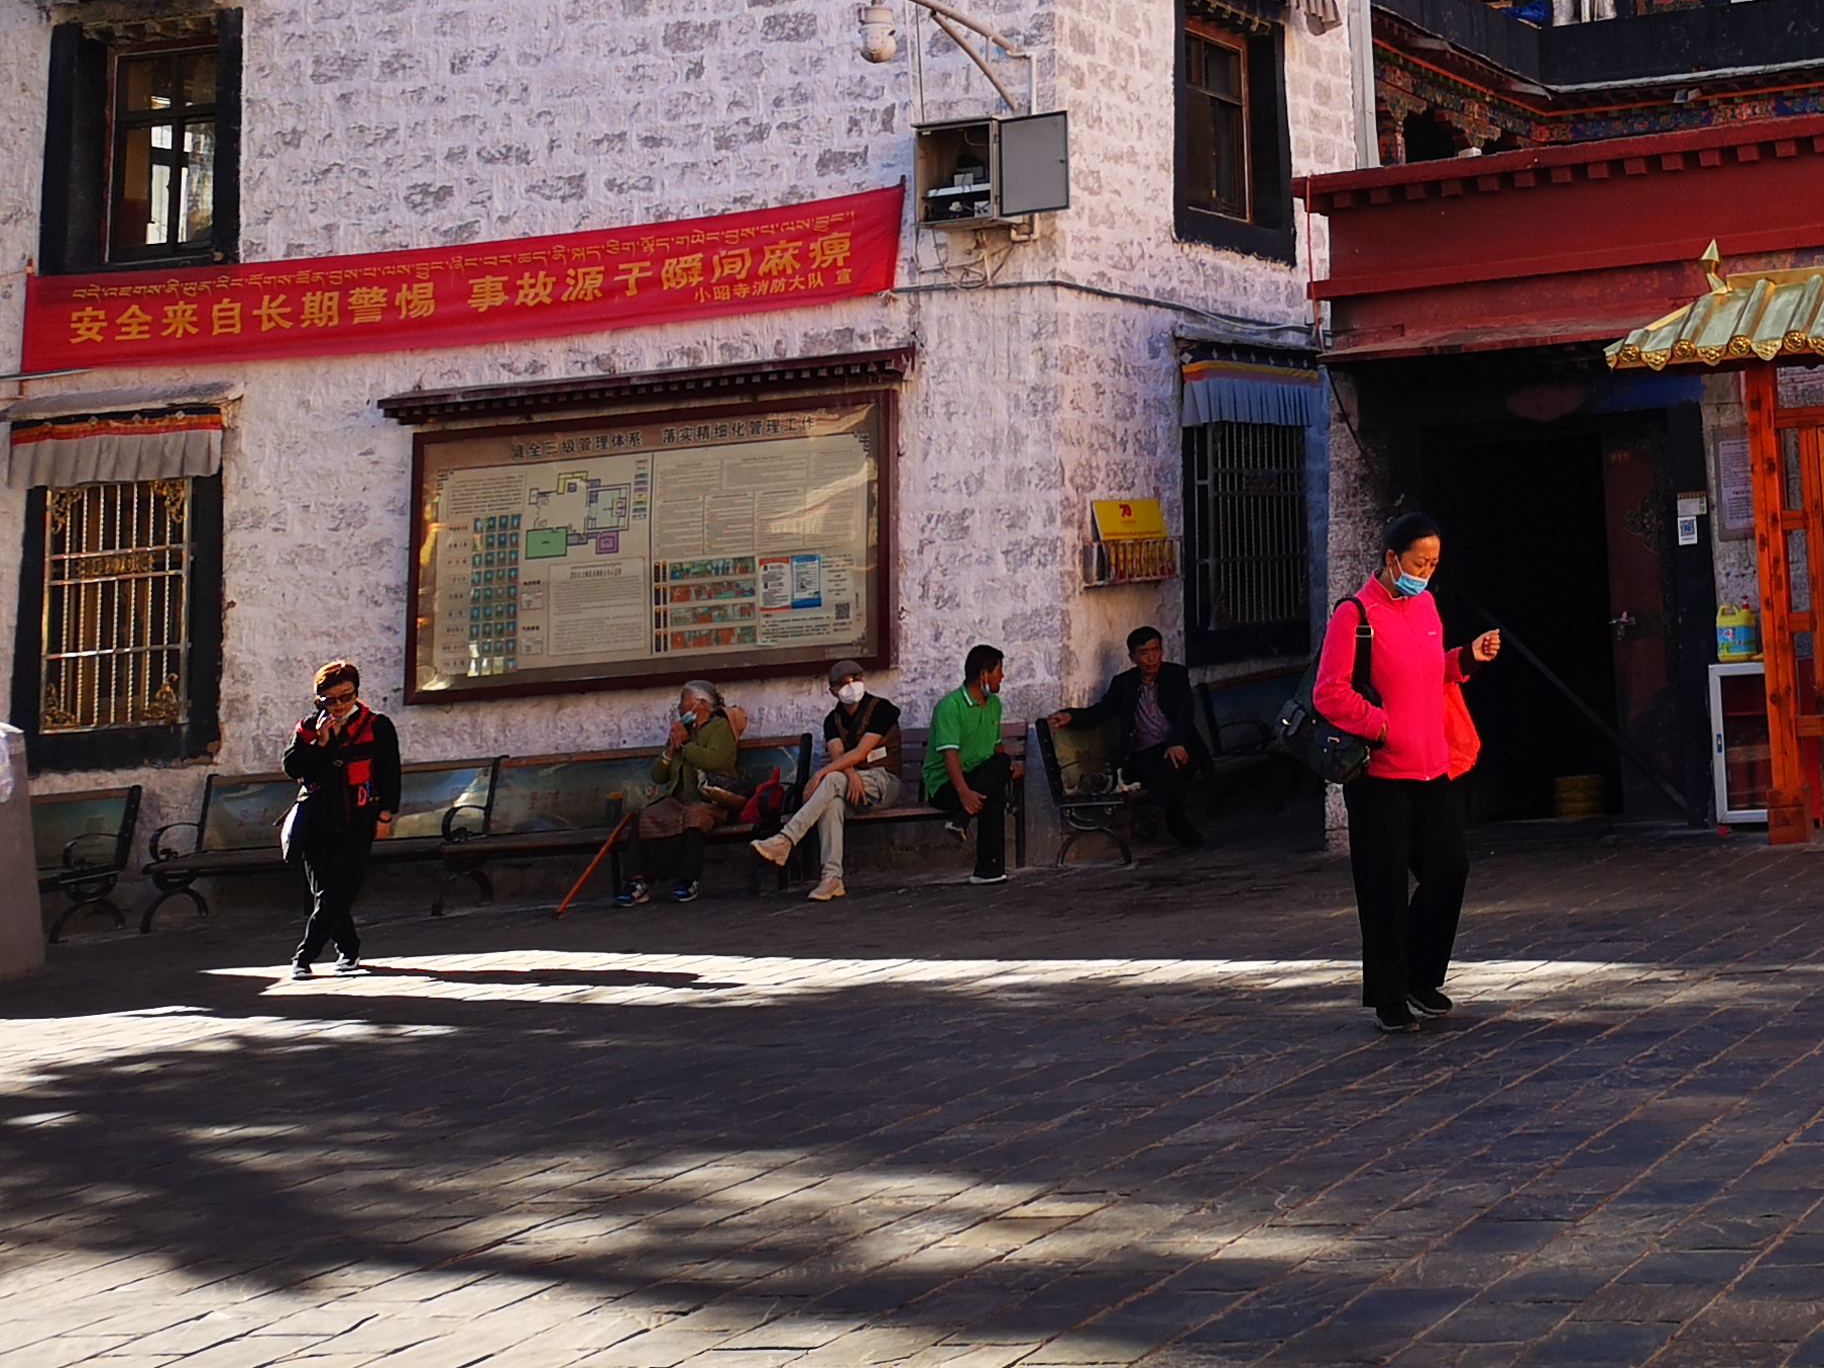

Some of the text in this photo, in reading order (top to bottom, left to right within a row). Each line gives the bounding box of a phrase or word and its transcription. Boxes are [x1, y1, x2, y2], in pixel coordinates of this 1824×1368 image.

[70, 232, 850, 344] 安全来自长期警惕 事故源于瞬间麻痹
[694, 270, 853, 304] 小昭寺消防大队 宣
[512, 415, 817, 460] 健全三级管理体系 落实精细化管理工作
